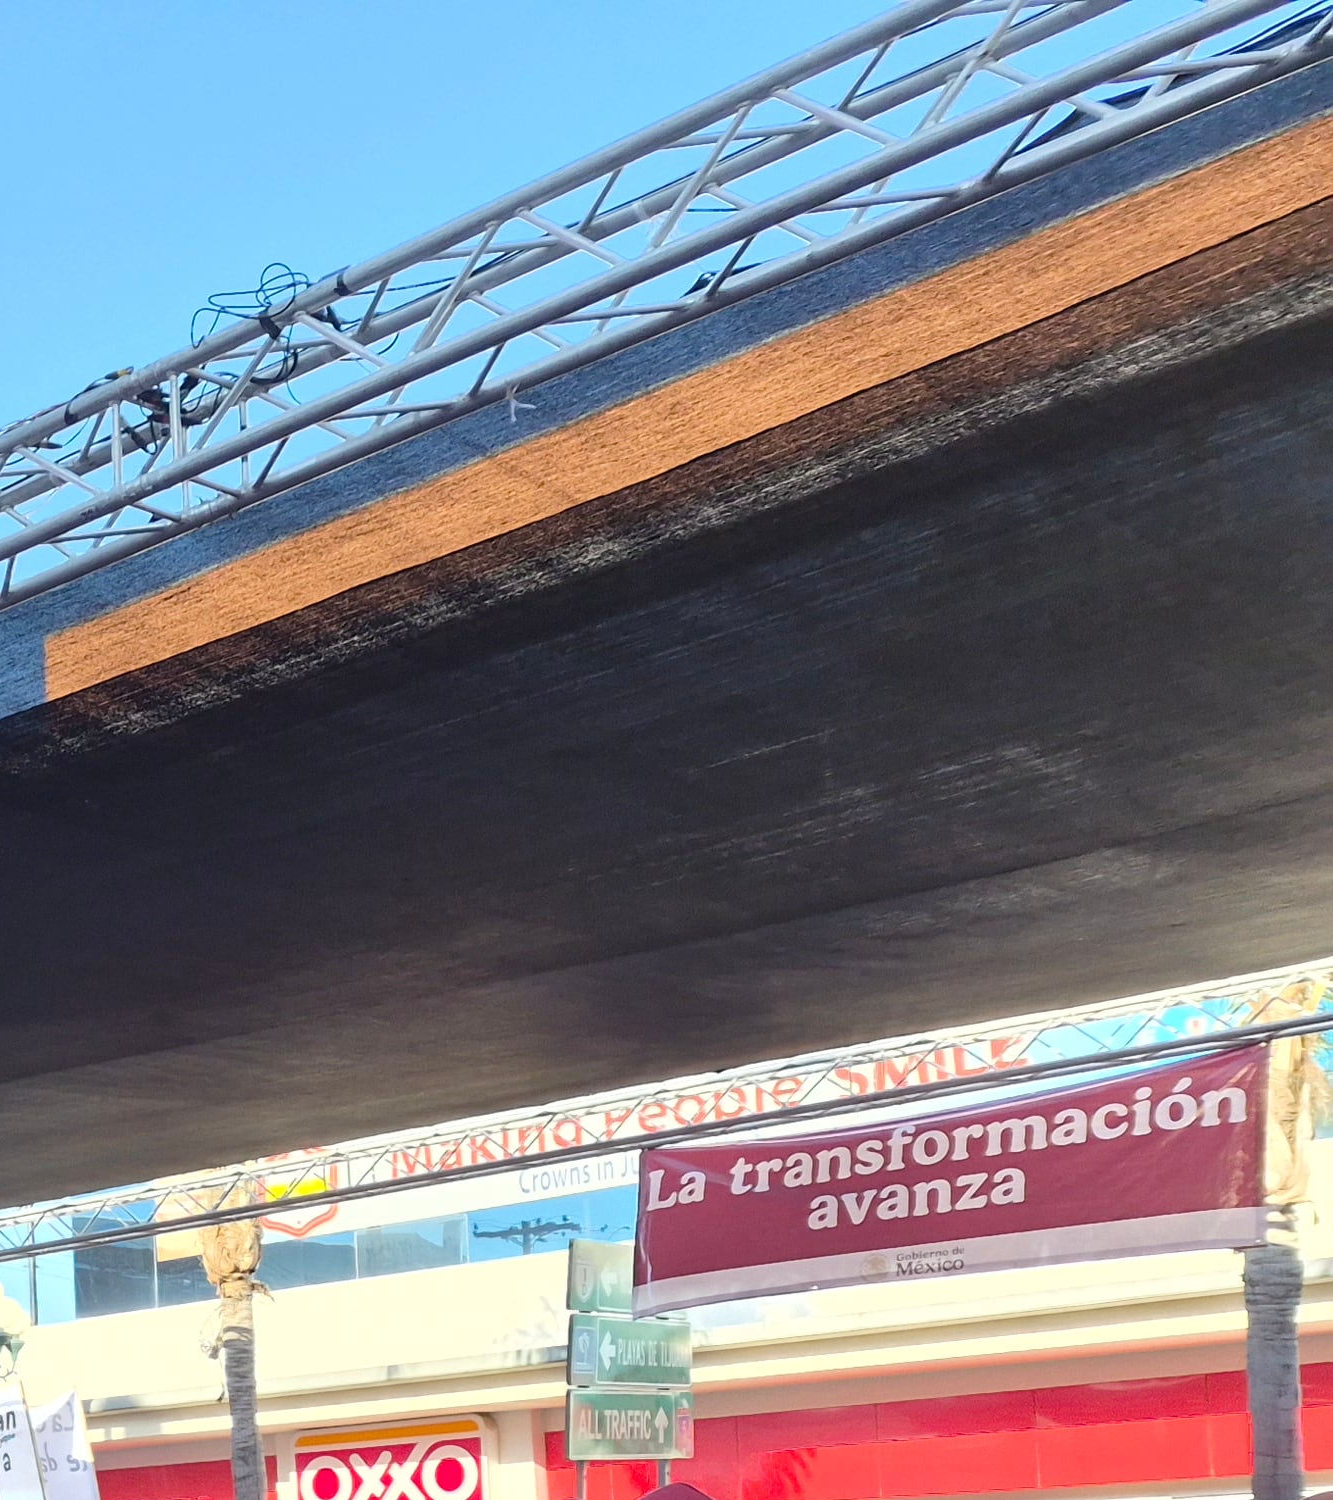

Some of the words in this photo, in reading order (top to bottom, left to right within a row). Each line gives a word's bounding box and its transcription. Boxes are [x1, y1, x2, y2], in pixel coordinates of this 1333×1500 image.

[646, 1169, 706, 1212] La
[729, 1077, 1247, 1196] transformación
[519, 1164, 590, 1193] Crowns
[598, 1160, 614, 1181] in
[807, 1167, 1027, 1231] avanza
[896, 1248, 949, 1262] Gobierno
[952, 1246, 965, 1256] de
[896, 1258, 965, 1277] México
[617, 1339, 646, 1367] PLAYAS
[648, 1341, 658, 1367] DE
[579, 1408, 602, 1440] ALL
[604, 1409, 652, 1440] TRAFFIC
